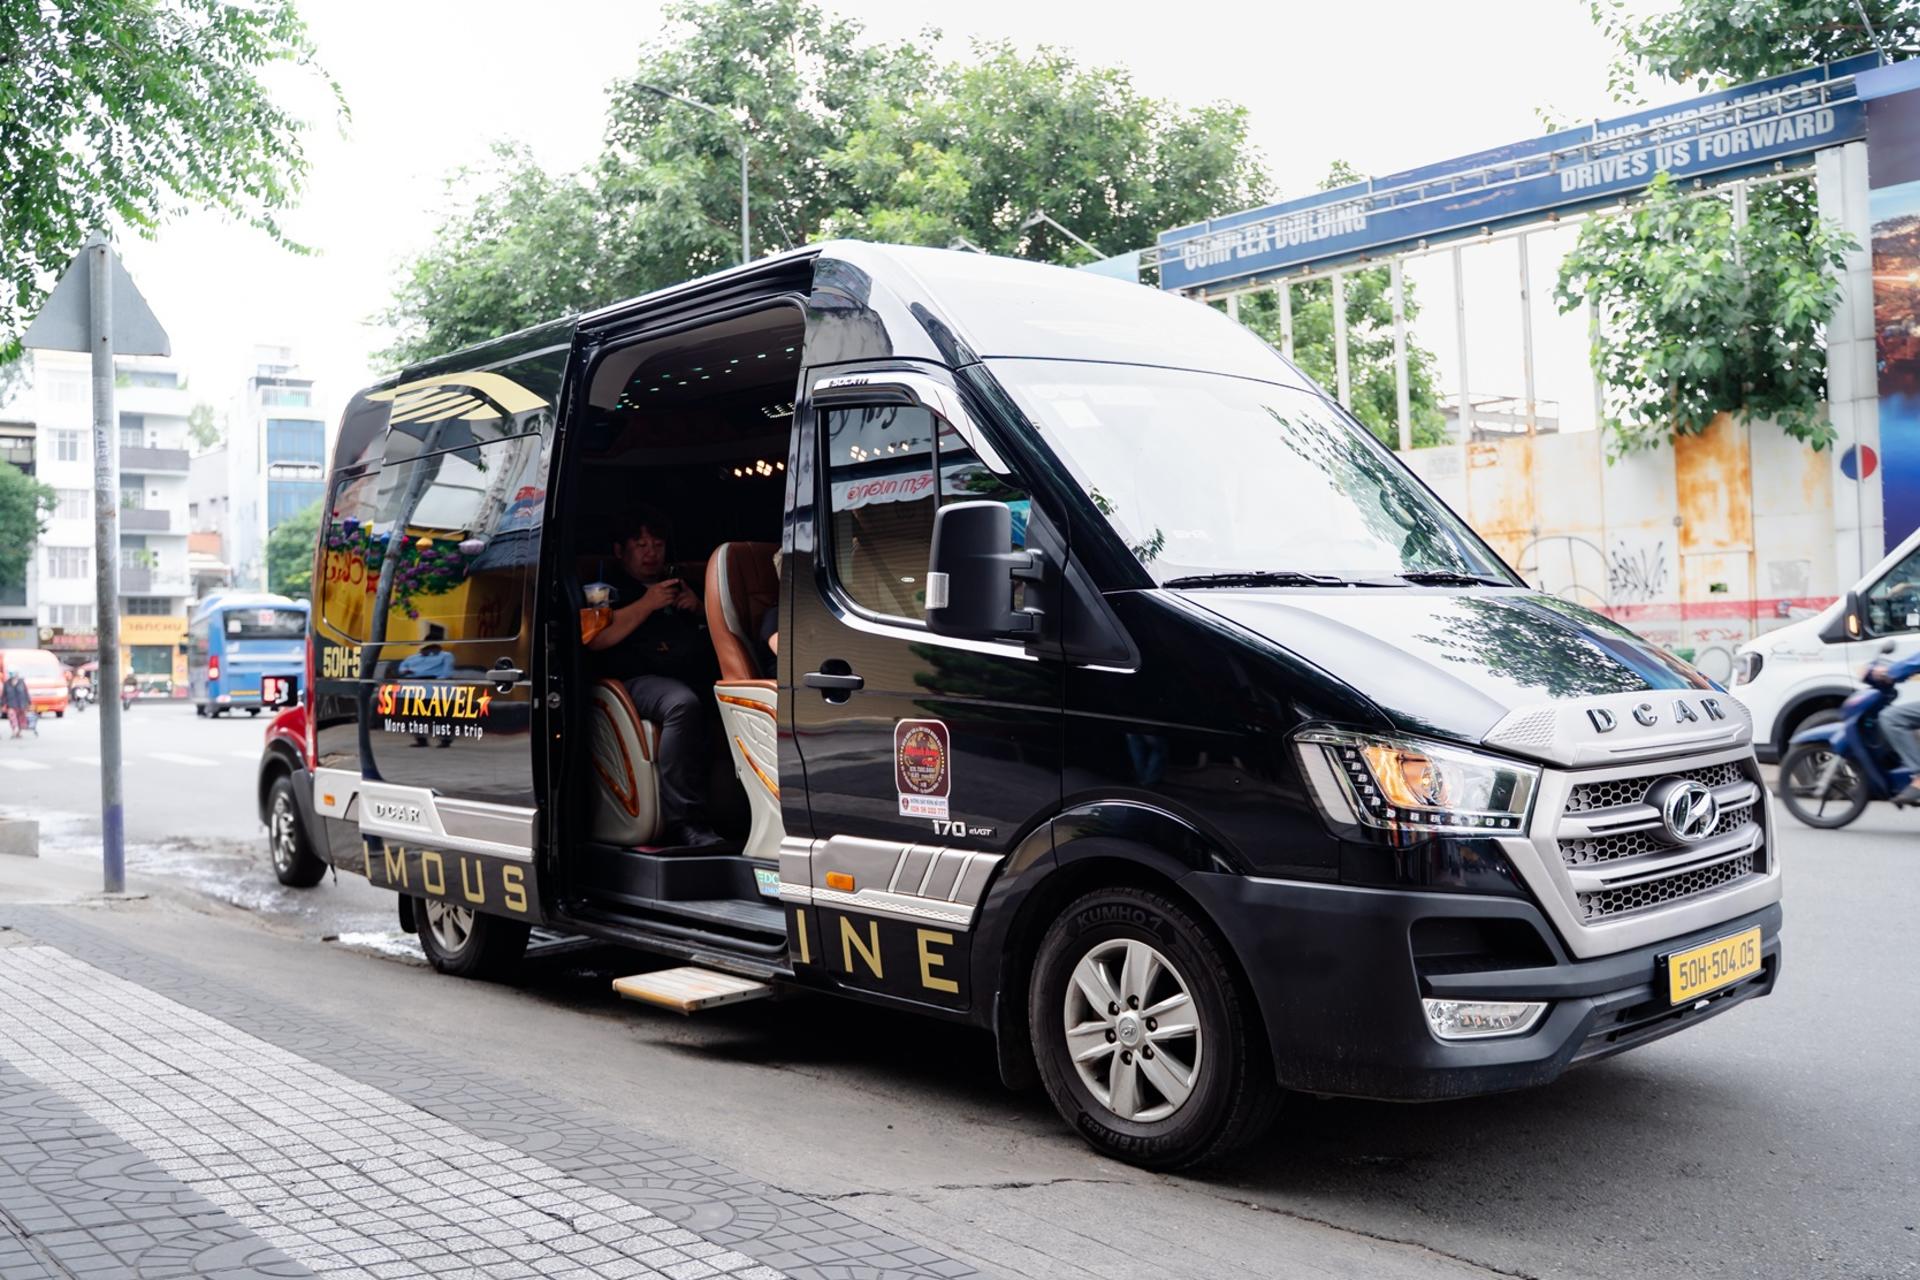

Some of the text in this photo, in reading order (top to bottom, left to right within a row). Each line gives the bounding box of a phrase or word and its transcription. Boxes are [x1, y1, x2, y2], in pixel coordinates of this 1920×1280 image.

[1560, 108, 1836, 193] DRIVES US FORWARD
[401, 685, 479, 719] TRAVEL
[1586, 697, 1726, 734] DCAR
[384, 718, 483, 740] More than just a trip
[374, 801, 421, 823] DCAR
[932, 819, 967, 837] 170
[1076, 905, 1147, 928] KUMHO
[1679, 938, 1755, 991] 50H-504.05
